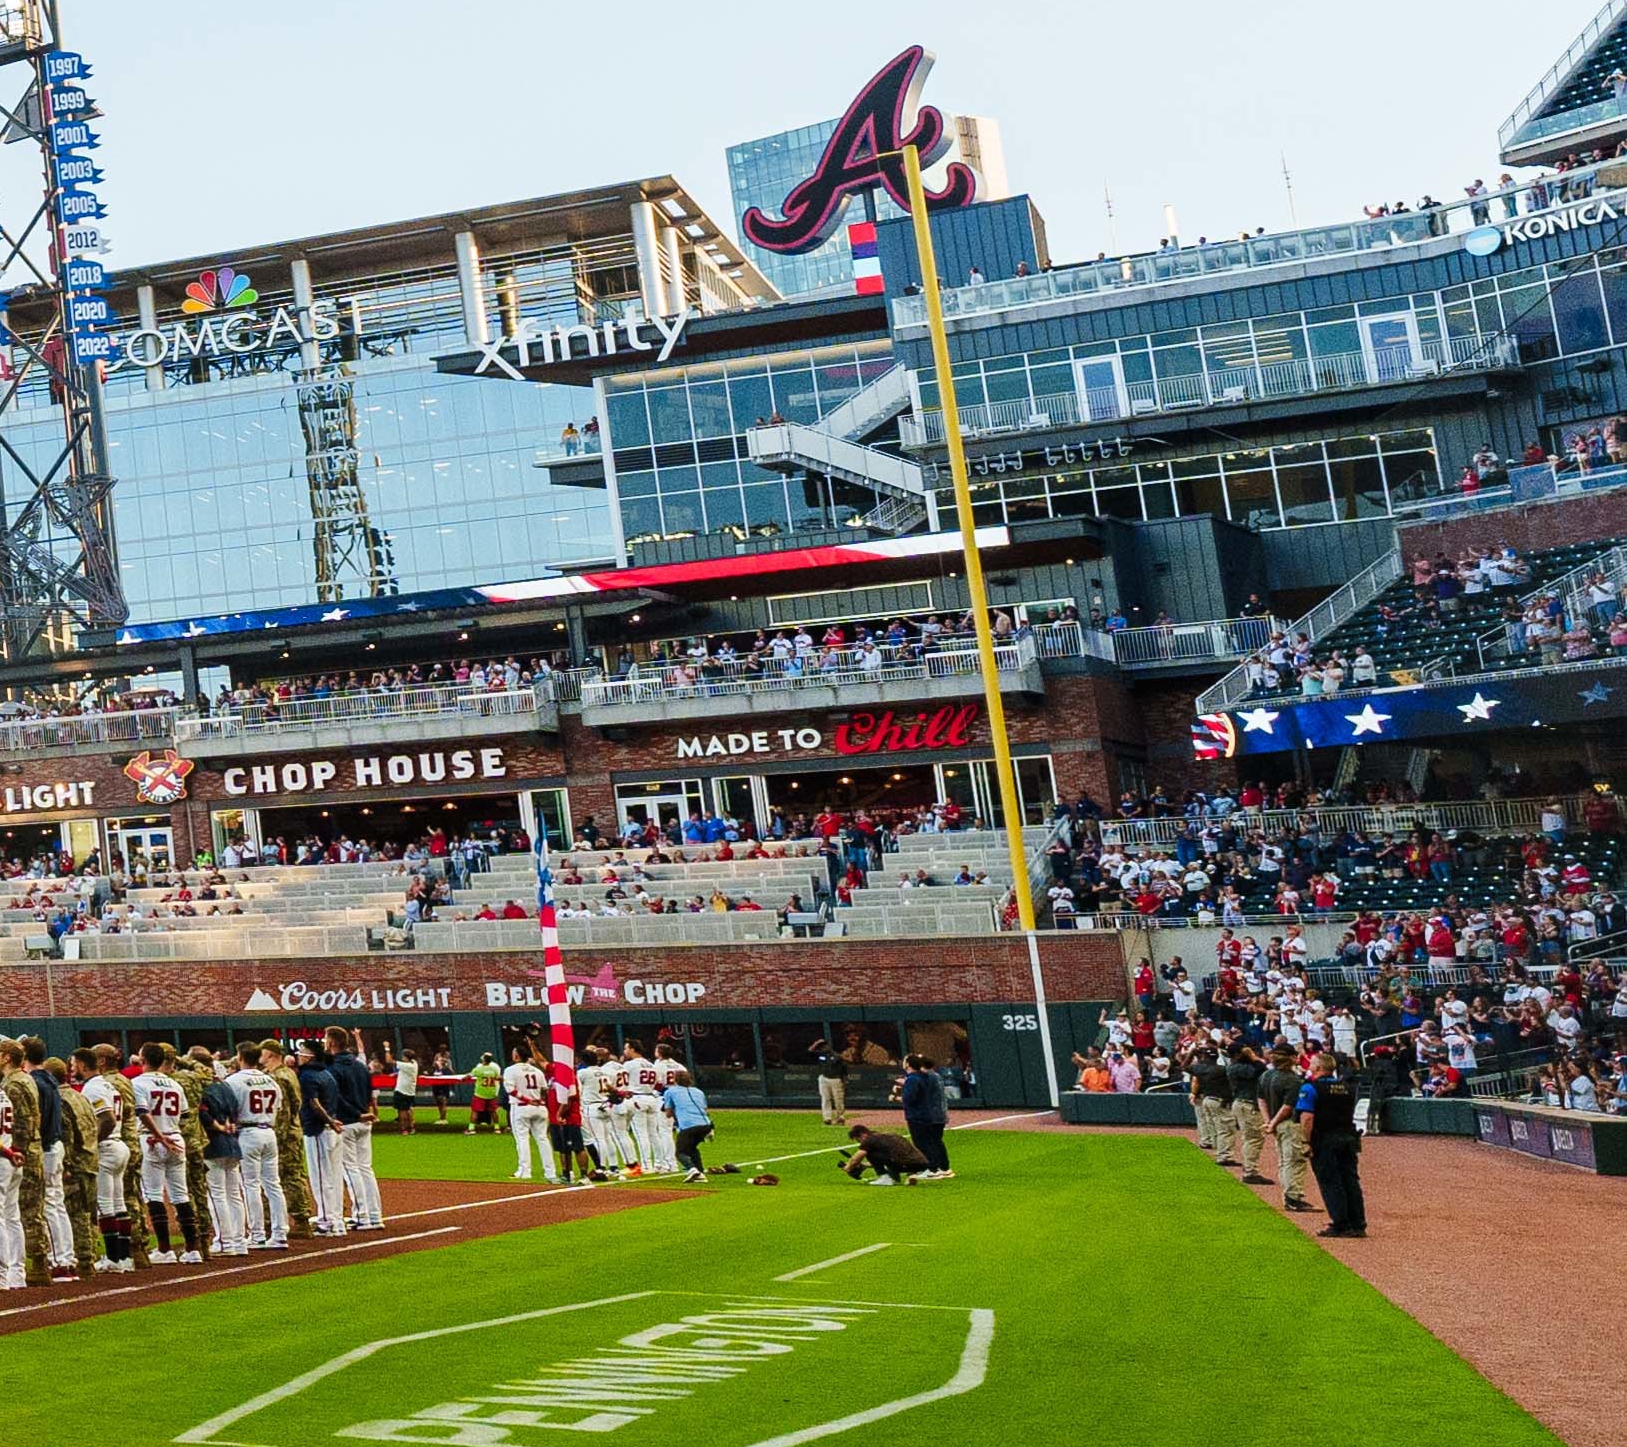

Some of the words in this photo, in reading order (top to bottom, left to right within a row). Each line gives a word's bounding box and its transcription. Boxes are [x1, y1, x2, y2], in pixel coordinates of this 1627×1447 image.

[49, 57, 79, 77] 1997
[53, 92, 85, 110] 1999
[57, 126, 88, 145] 2001
[742, 44, 977, 254] A
[61, 161, 92, 180] 2003
[64, 196, 96, 215] 2005
[1504, 202, 1618, 245] KONICA
[69, 231, 97, 248] 2012
[71, 266, 101, 285] 2018
[75, 302, 105, 320] 2020
[78, 337, 109, 355] 2022
[474, 306, 693, 380] xfinity
[678, 730, 770, 757] MADE
[778, 728, 821, 751] TO
[835, 703, 978, 755] Chill
[225, 760, 335, 795] CHOP
[356, 747, 506, 786] HOUSE
[5, 780, 95, 811] LIGHT
[279, 981, 365, 1012] Coors
[373, 987, 452, 1010] LIGHT
[592, 986, 616, 1000] THE
[624, 979, 705, 1005] CHOP
[1003, 1015, 1037, 1031] 325
[525, 1074, 537, 1089] 11
[616, 1072, 629, 1087] 20
[639, 1070, 656, 1085] 28
[150, 1091, 179, 1116] 73
[249, 1090, 276, 1114] 67
